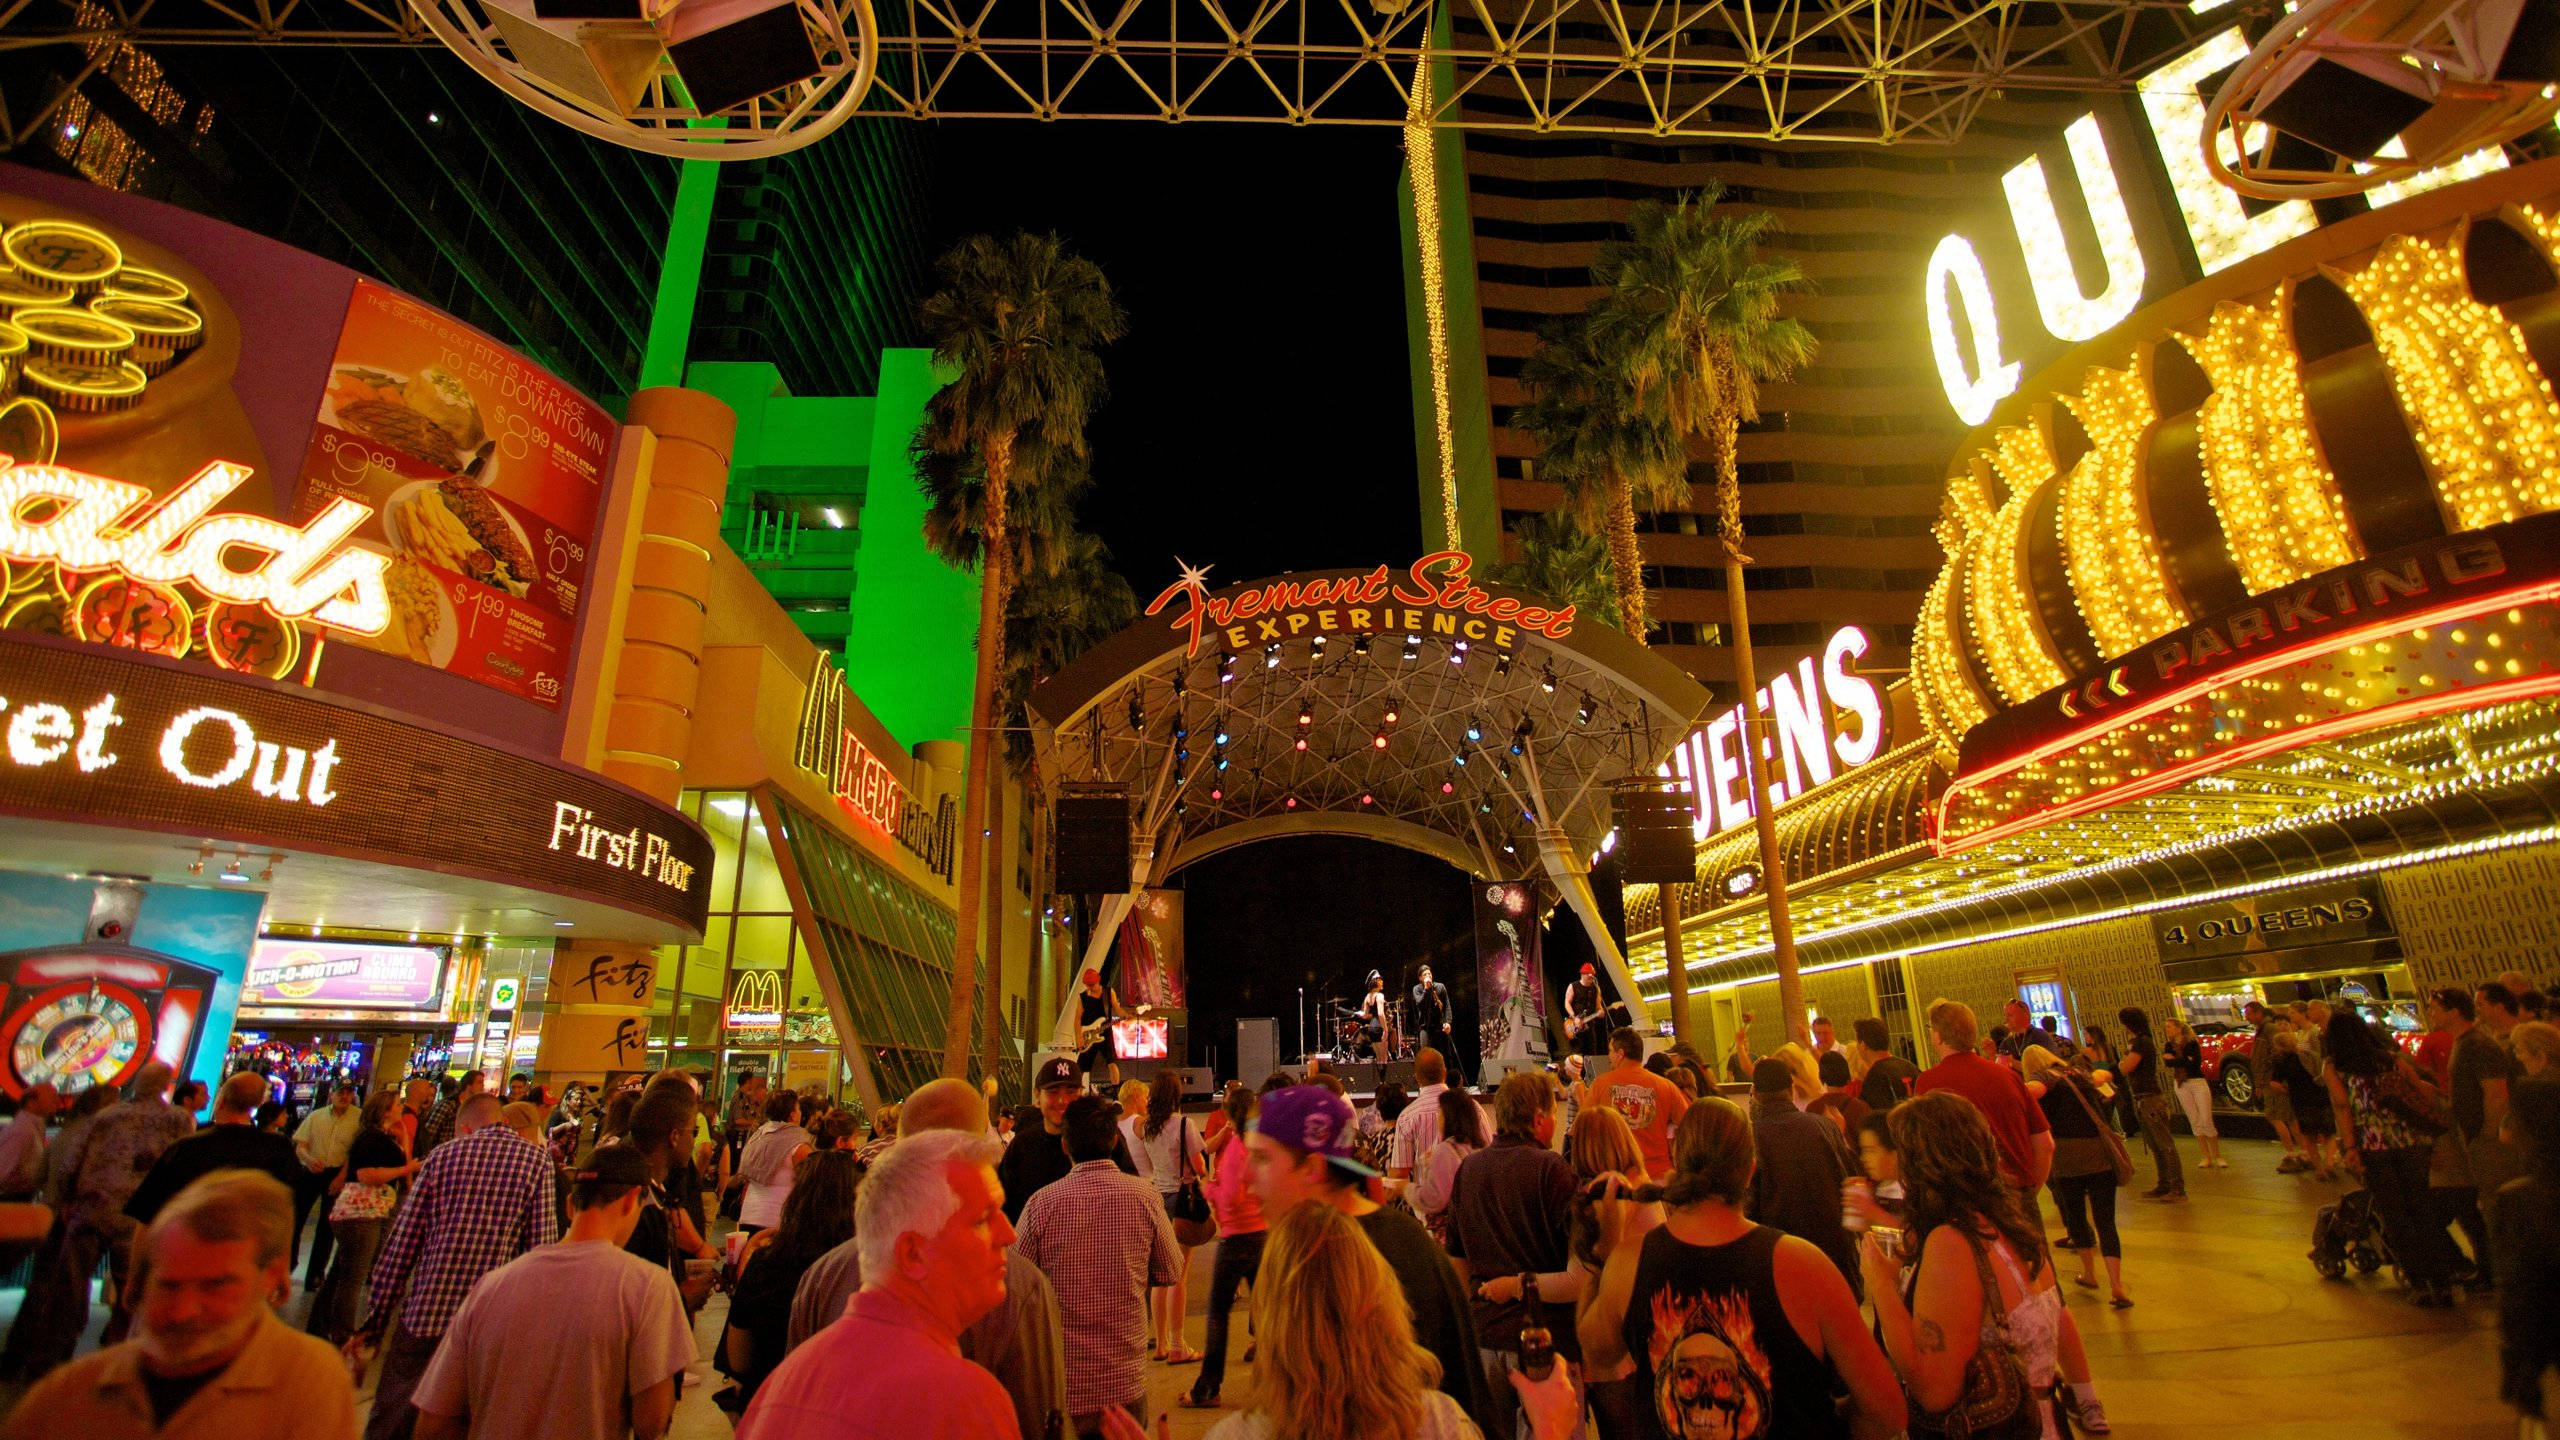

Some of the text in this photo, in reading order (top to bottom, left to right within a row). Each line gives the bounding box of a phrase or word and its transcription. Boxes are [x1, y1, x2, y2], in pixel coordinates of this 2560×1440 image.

[367, 295, 586, 421] THE SECRET IS OUT FITZ IS THE PLACE
[440, 347, 605, 456] TO EAT DOWNTOWN
[309, 486, 321, 495] OF
[310, 478, 334, 492] FULL
[337, 487, 370, 504] ORDER
[0, 452, 392, 638] alds
[506, 617, 547, 640] BREAKFAST
[1145, 551, 1576, 658] Fremont Street
[1230, 609, 1525, 649] EXPERIENCE
[2152, 538, 2507, 680] PARKING
[0, 692, 341, 807] et Out
[548, 800, 696, 892] First Floor
[2165, 898, 2373, 944] 4 QUEENS
[249, 958, 360, 987] UCK-O-MOTION
